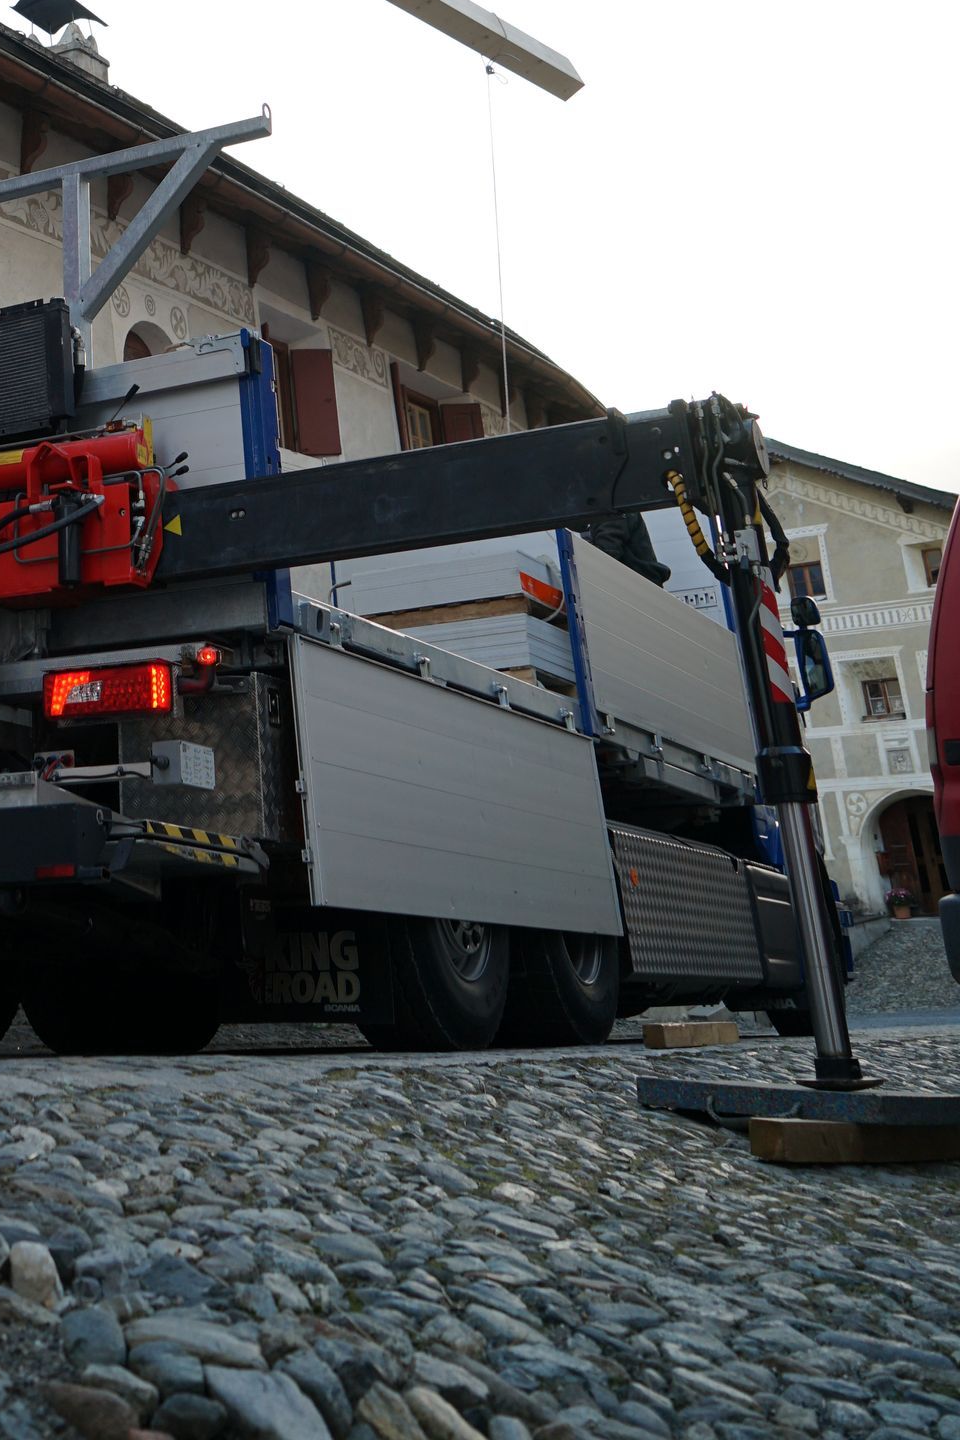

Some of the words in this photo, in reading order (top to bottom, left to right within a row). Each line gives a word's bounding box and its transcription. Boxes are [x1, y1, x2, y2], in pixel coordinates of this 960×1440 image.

[264, 929, 360, 971] KING
[272, 970, 361, 1004] ROAD
[323, 1003, 361, 1013] SCANIA
